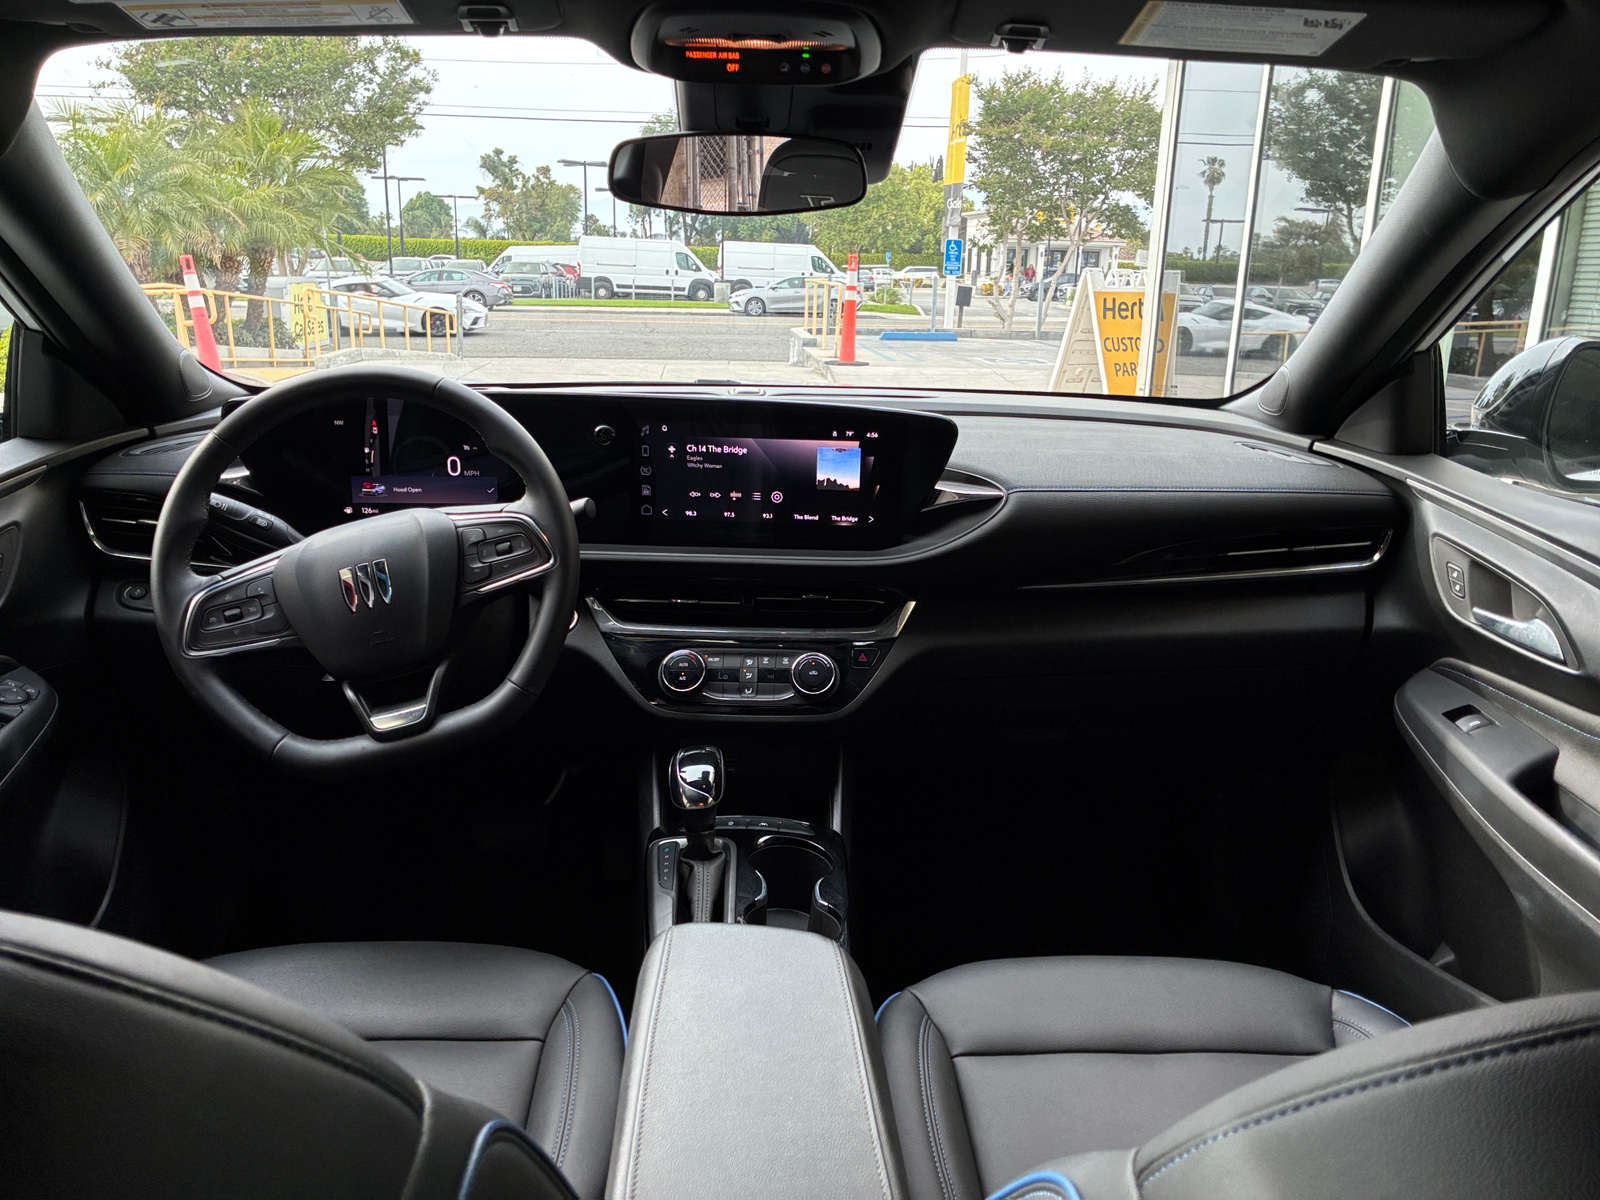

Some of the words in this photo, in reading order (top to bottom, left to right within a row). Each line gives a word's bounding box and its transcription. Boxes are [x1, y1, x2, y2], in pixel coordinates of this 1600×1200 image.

[685, 50, 718, 59] PASSENGER
[718, 51, 728, 60] AIR
[728, 51, 740, 60] BAG
[726, 63, 740, 72] OFF
[1103, 297, 1144, 320] Hert
[1104, 337, 1141, 352] CUSTO
[1114, 361, 1139, 377] PAR
[686, 444, 698, 453] Ch
[698, 444, 707, 453] 14
[707, 445, 722, 454] The
[723, 445, 748, 456] Bridge
[686, 454, 704, 462] Eagles
[446, 456, 461, 477] 0
[687, 462, 704, 470] Witchy
[407, 486, 423, 494] Open
[841, 515, 859, 523] Bridge
